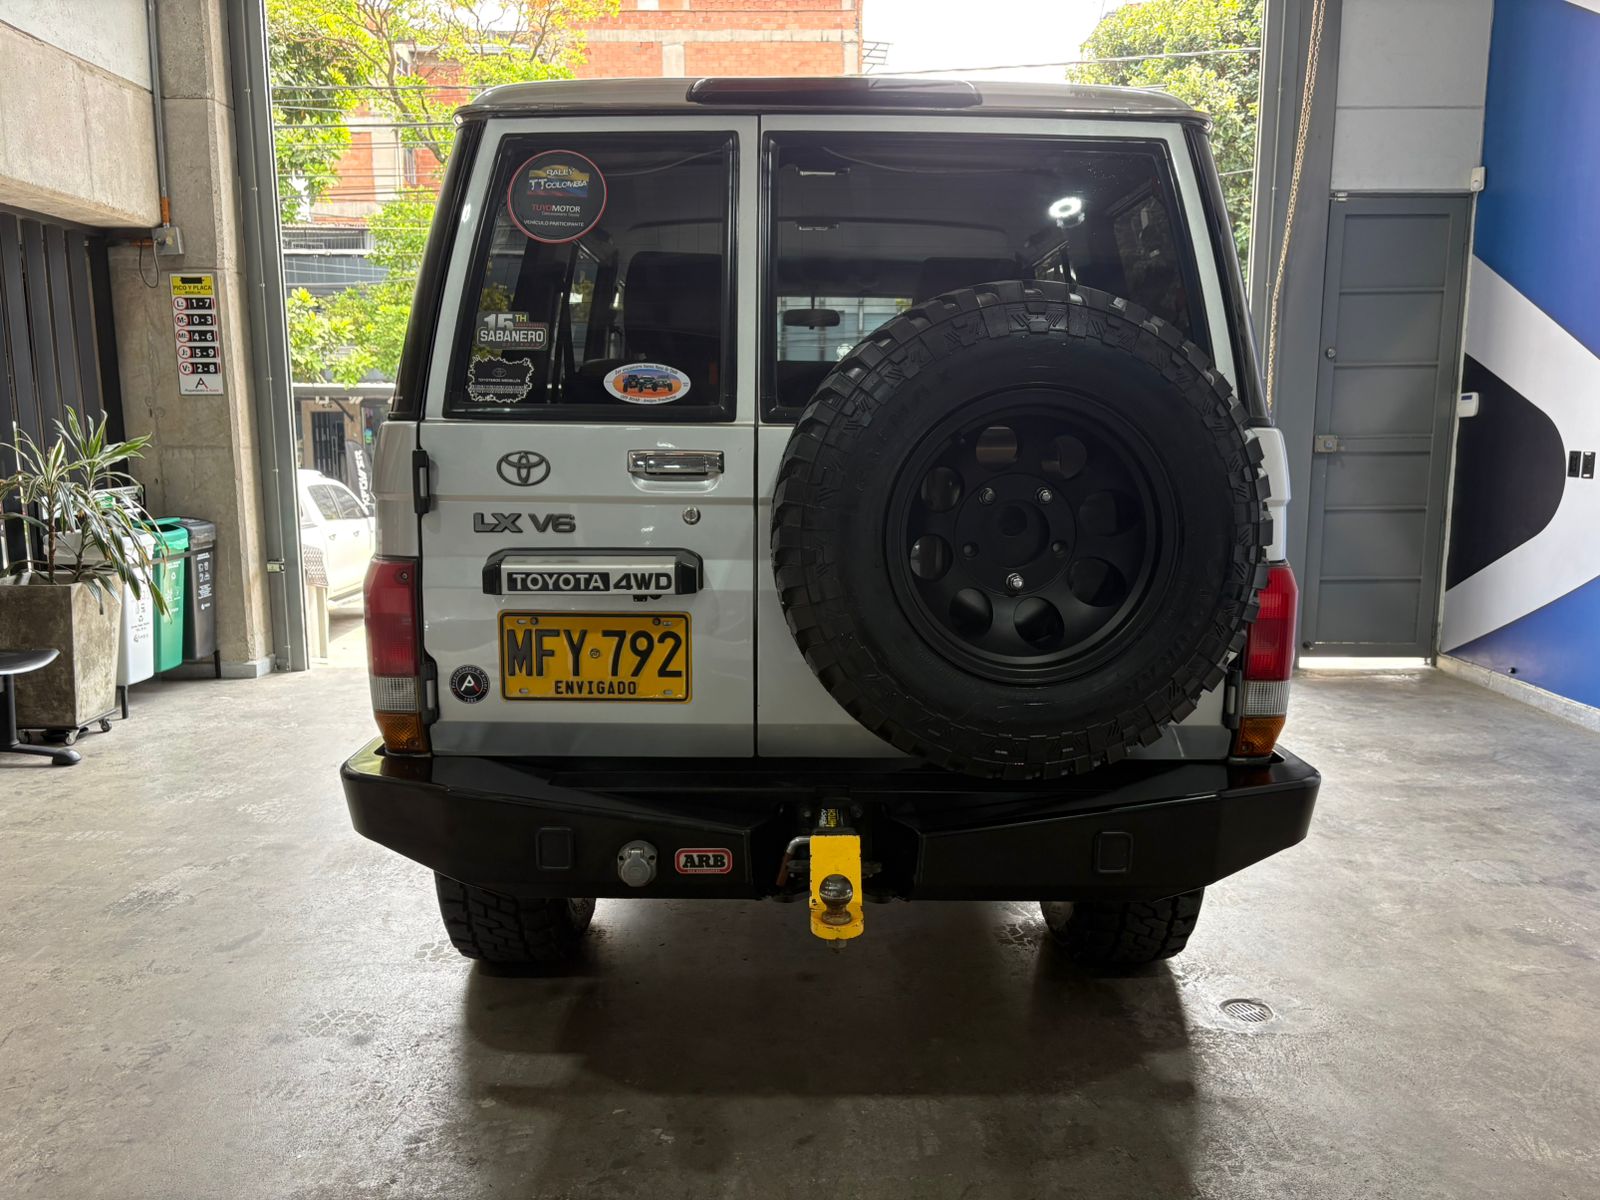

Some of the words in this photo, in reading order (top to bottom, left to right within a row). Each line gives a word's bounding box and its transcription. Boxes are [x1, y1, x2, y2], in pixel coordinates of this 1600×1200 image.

[480, 330, 544, 343] SABANERO
[473, 512, 523, 533] LX
[528, 513, 576, 533] V6
[512, 574, 605, 590] TOYOTA
[613, 573, 673, 591] 4WD
[506, 629, 588, 677] MFY
[602, 630, 683, 678] 792
[554, 680, 637, 695] ENVIGADO
[682, 854, 726, 869] ARB
